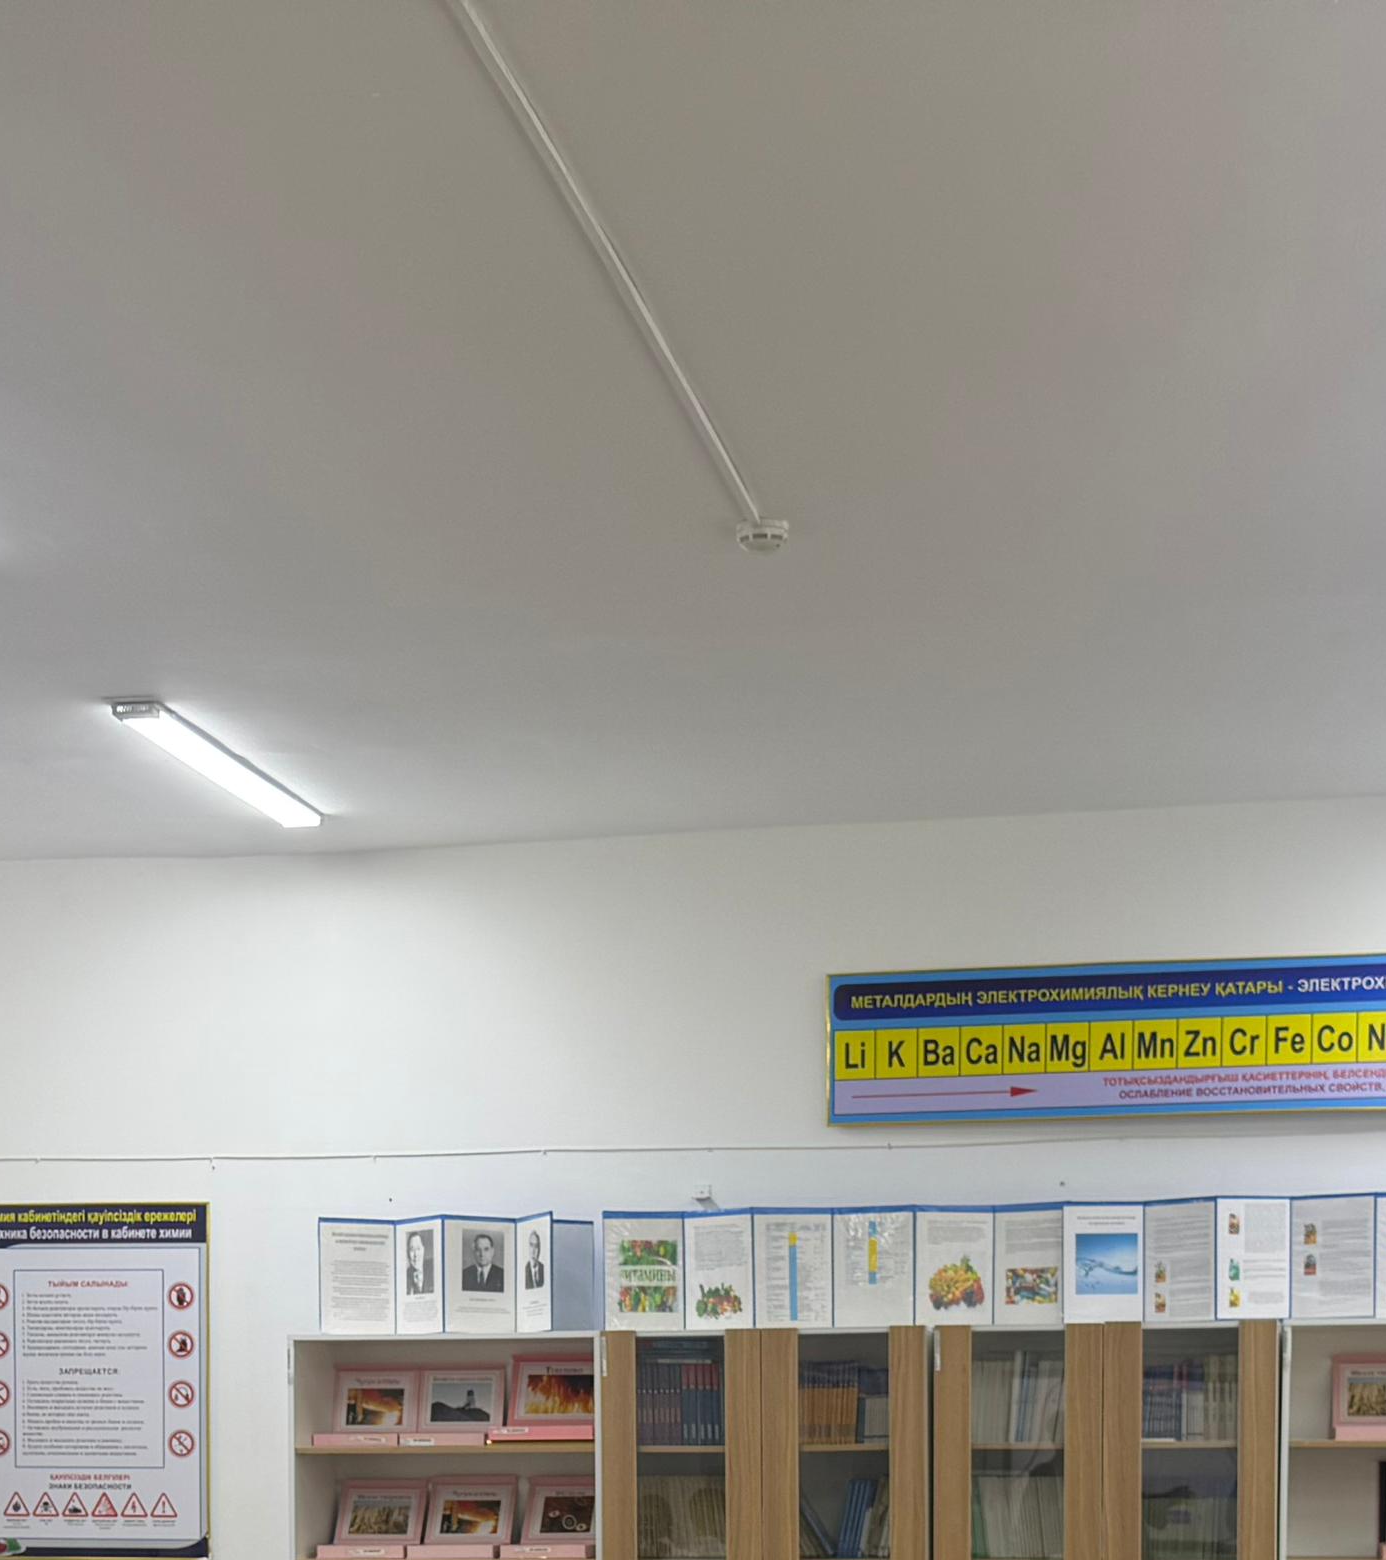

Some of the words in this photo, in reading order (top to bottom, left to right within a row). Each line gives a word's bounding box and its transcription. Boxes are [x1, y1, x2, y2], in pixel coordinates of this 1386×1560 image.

[850, 991, 974, 1011] МЕТАЛДАРДЫҢ
[976, 983, 1144, 1006] ЭЛЕКТРОХИМИЯЛЫҚ
[1148, 982, 1212, 1000] КЕРНЕУ
[1215, 979, 1284, 1000] ҚАТАРЫ
[845, 1042, 866, 1069] Li
[888, 1041, 905, 1068] K
[923, 1039, 956, 1067] Ba
[965, 1037, 998, 1065] Ca
[1008, 1036, 1041, 1063] Na
[1050, 1034, 1087, 1069] Mg
[1099, 1032, 1126, 1060] Al
[1137, 1032, 1174, 1060] Mn
[1184, 1029, 1217, 1057] Zn
[1229, 1028, 1260, 1055] Cr
[1274, 1027, 1306, 1054] Fe
[1317, 1025, 1354, 1053] Co
[1119, 1088, 1193, 1100] ОСЛАБЛЕНИЕ
[1196, 1083, 1327, 1097] ВОССТАНОВИТЕЛЬНЫХ
[29, 1226, 100, 1240] безопасности
[101, 1228, 109, 1239] в
[111, 1225, 157, 1239] кабинете
[158, 1228, 192, 1239] химии
